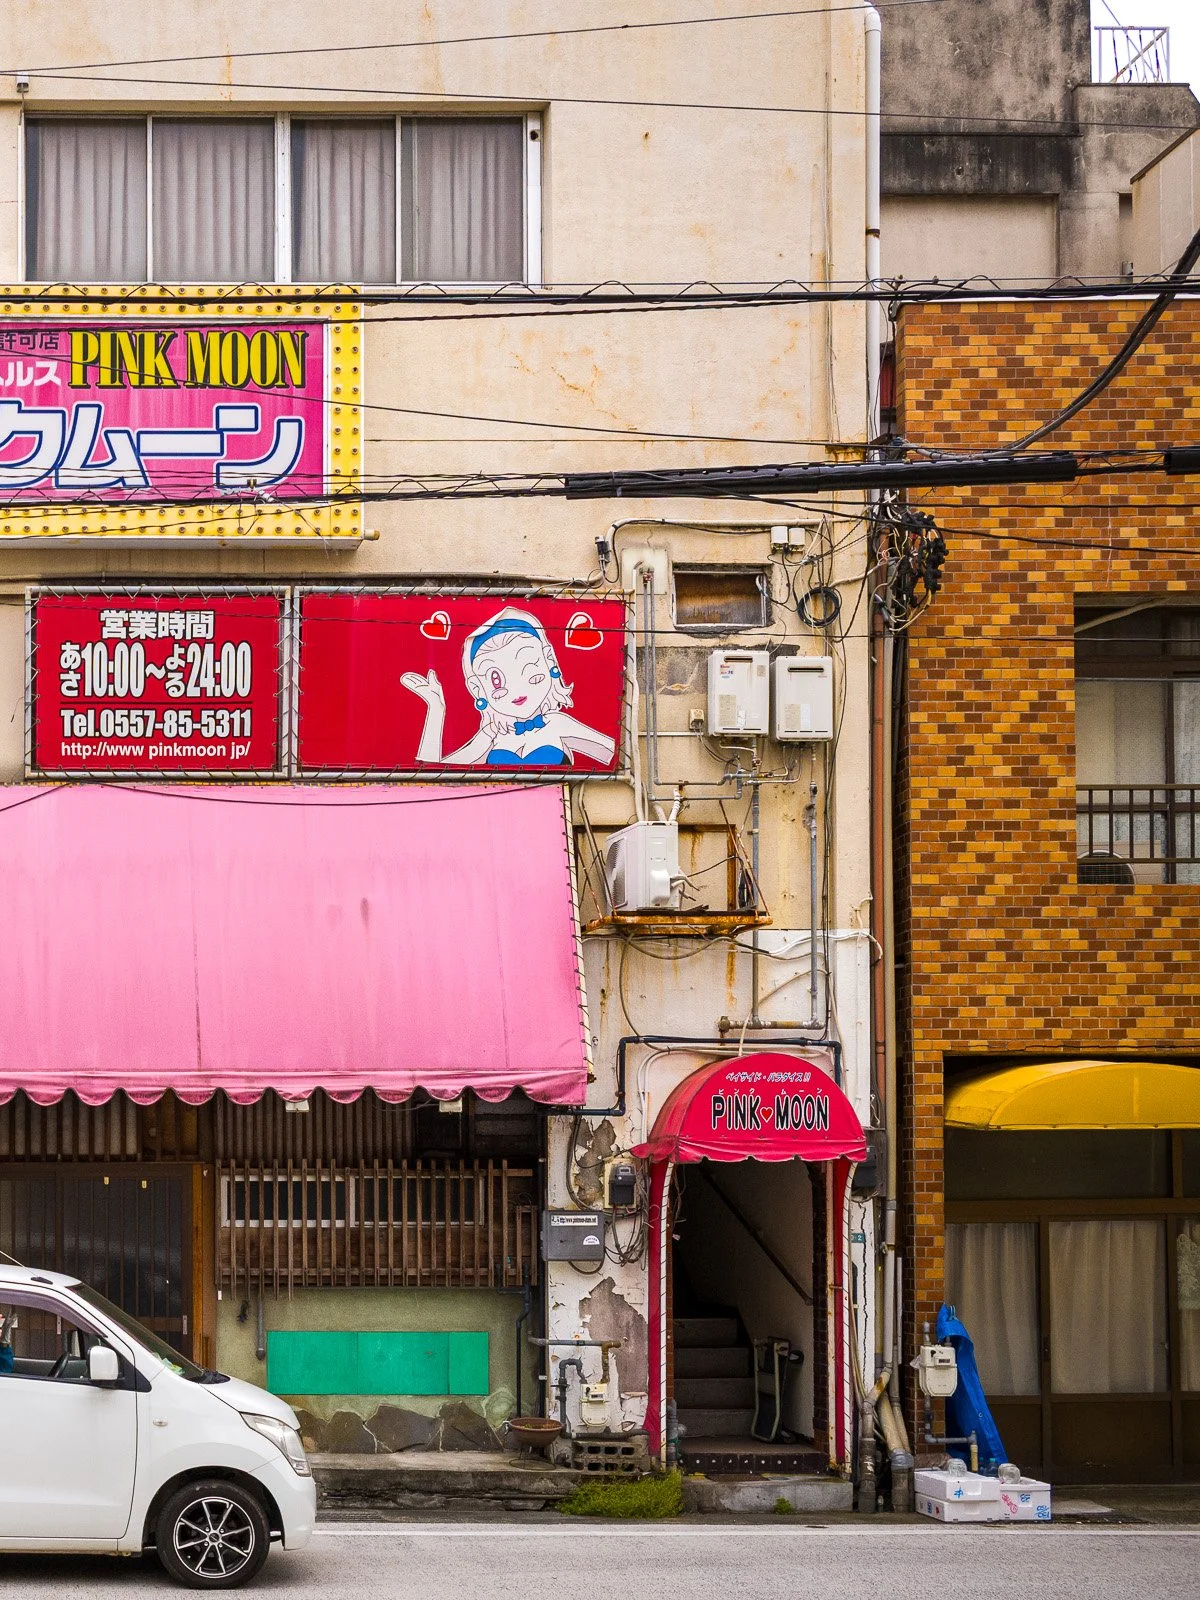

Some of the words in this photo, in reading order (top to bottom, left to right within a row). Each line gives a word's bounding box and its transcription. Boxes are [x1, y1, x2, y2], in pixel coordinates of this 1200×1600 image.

[69, 331, 180, 389] PINK
[186, 331, 306, 389] MOON
[99, 610, 215, 640] 営業時間
[60, 708, 252, 738] Tel.0557-85-5311
[712, 1094, 762, 1131] PINK
[774, 1094, 830, 1131] MOON
